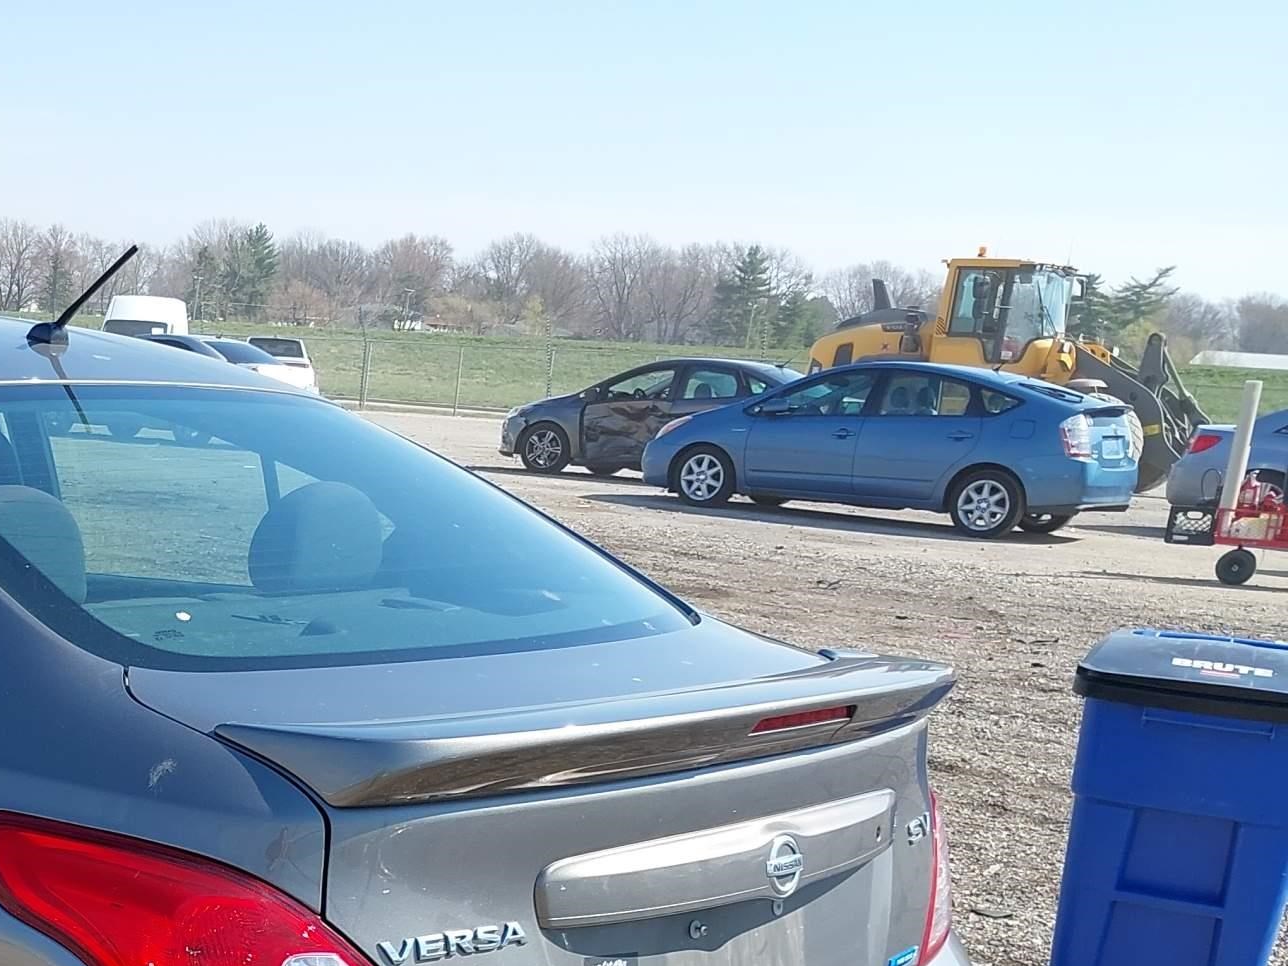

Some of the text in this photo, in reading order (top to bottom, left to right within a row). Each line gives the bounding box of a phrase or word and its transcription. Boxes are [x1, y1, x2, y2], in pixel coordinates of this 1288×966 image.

[1171, 657, 1274, 677] BRUTE
[906, 811, 931, 845] SV
[773, 858, 803, 873] NISSAN
